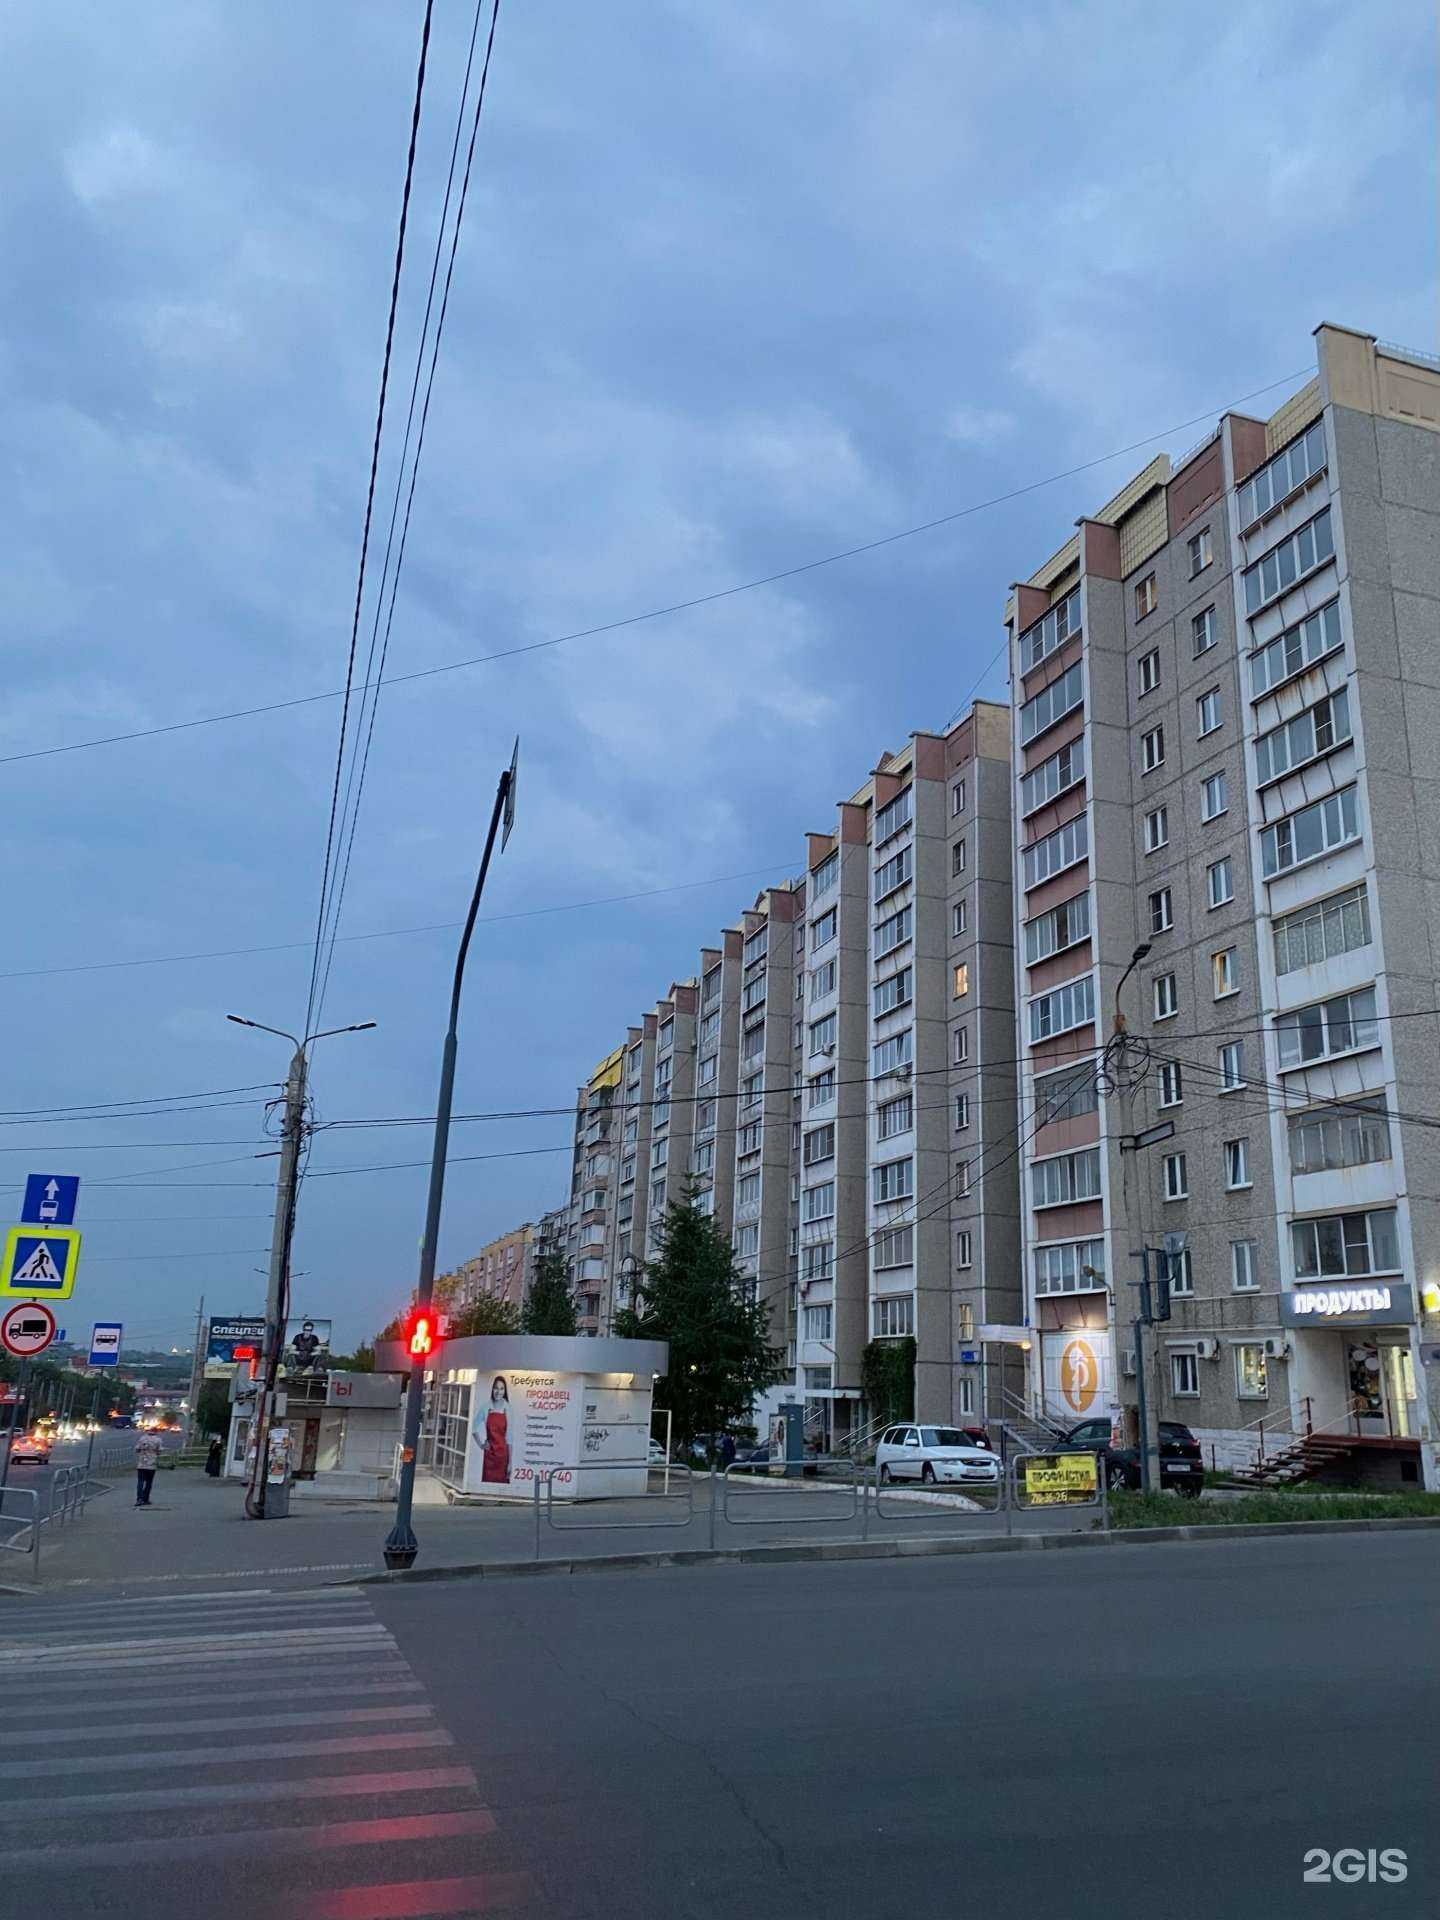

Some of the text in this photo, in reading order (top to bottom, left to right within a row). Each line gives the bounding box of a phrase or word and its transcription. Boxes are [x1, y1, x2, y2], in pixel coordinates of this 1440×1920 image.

[1294, 1288, 1391, 1316] ПРОДУКТЫ
[510, 1376, 555, 1387] Требуется
[527, 1390, 570, 1400] ПРОДАВЕЦ
